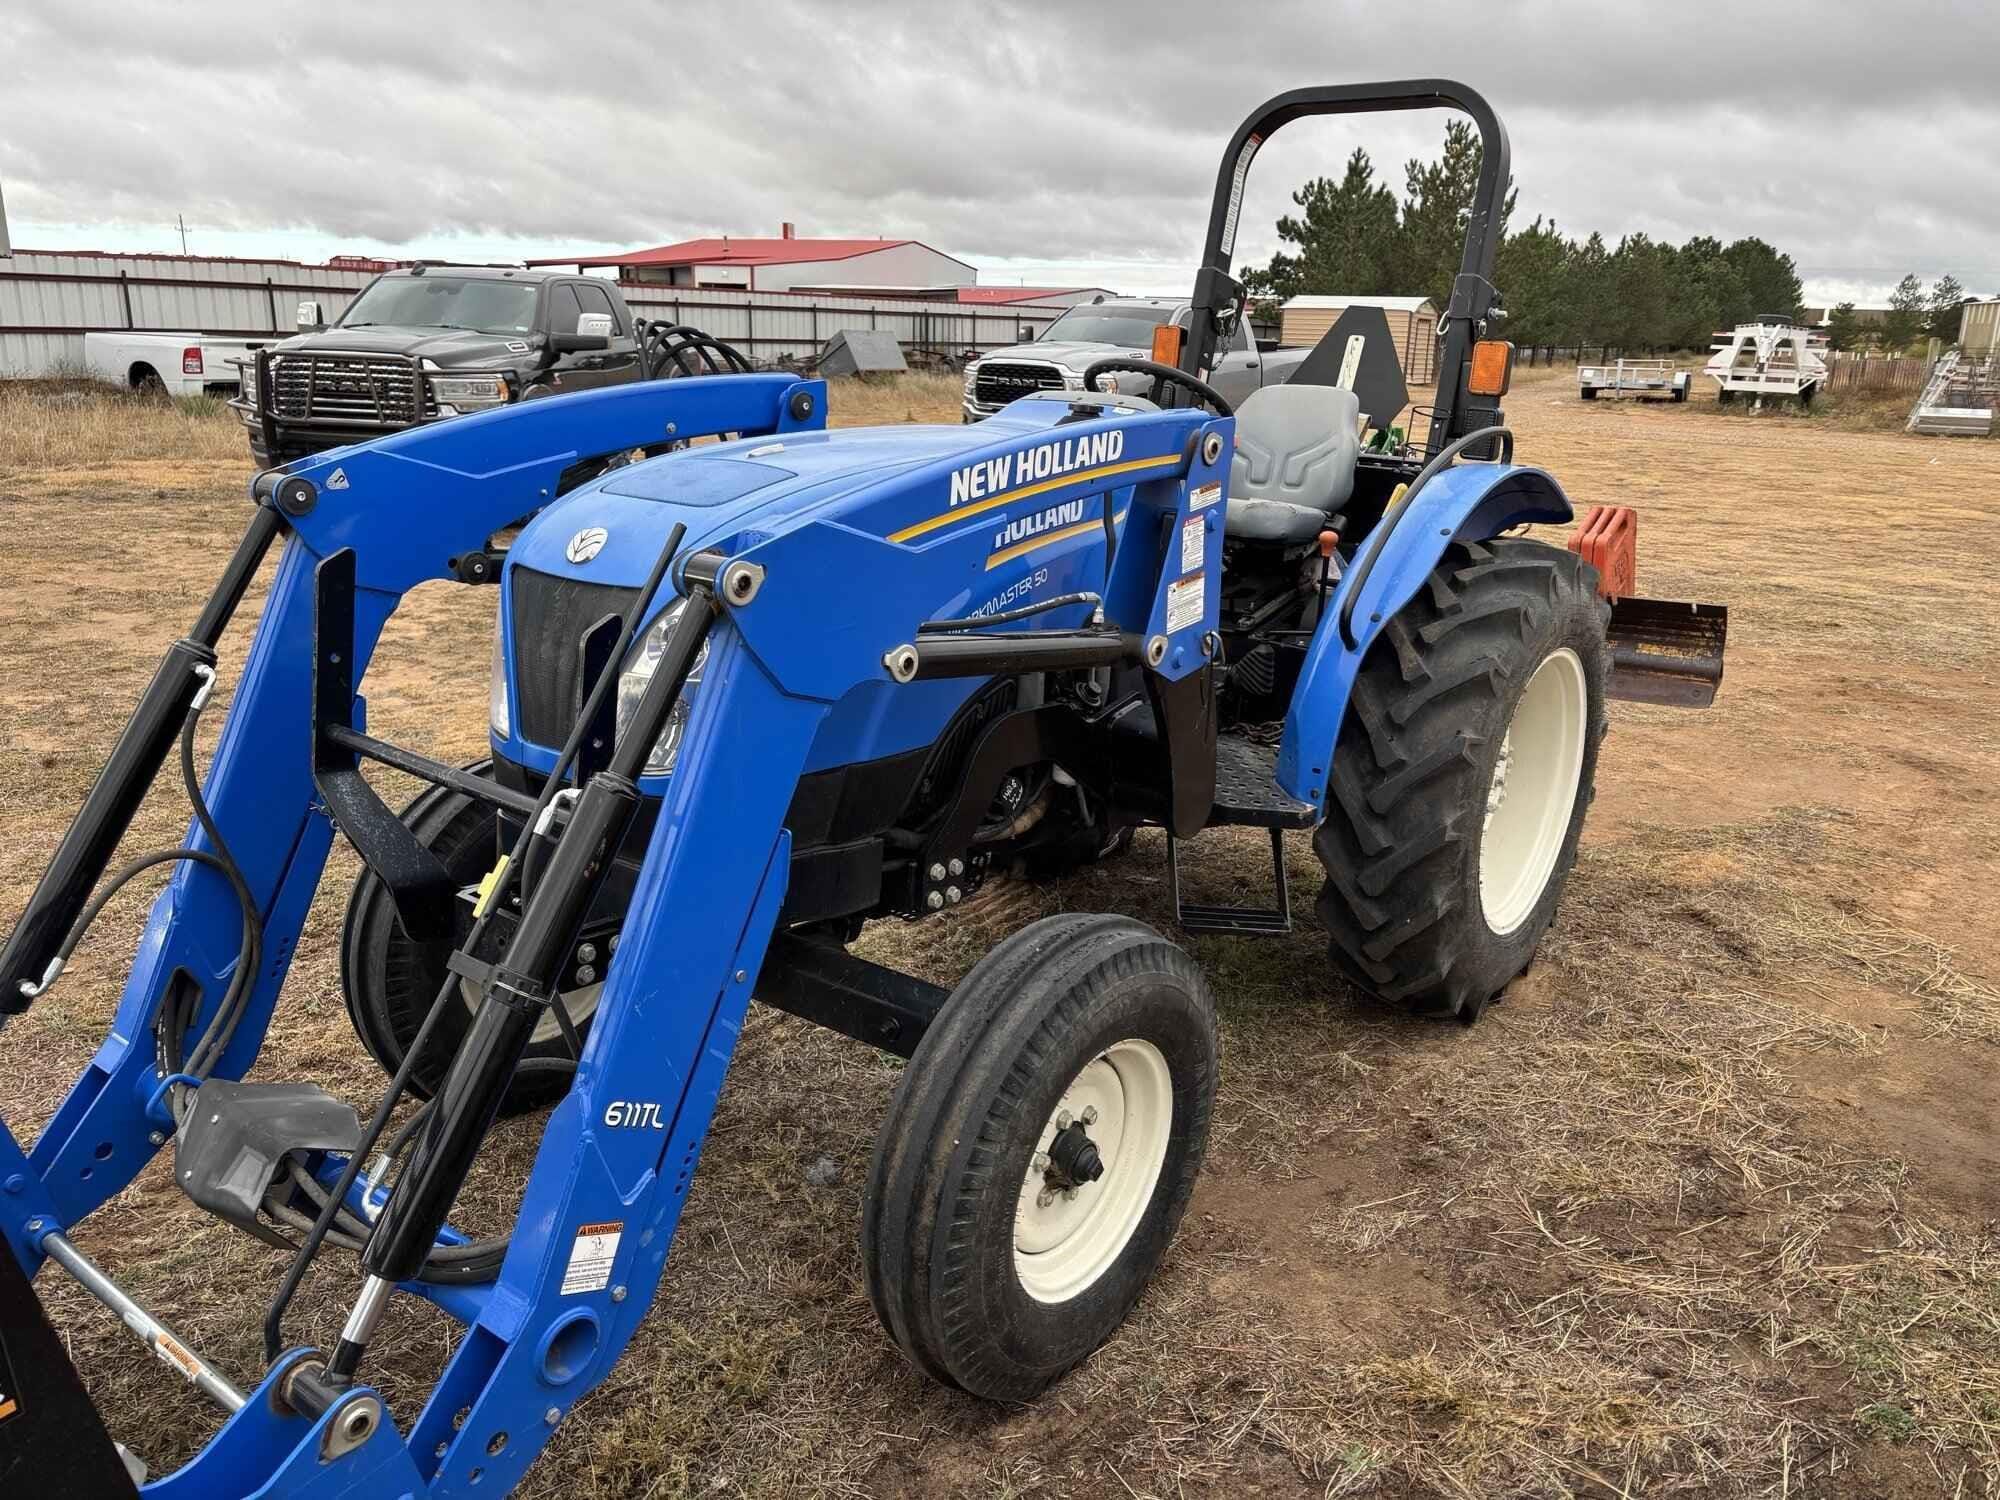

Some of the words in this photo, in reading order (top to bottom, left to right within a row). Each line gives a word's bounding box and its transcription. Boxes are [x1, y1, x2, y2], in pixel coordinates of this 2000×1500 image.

[998, 377, 1036, 387] RAM
[950, 455, 1012, 506] NEW
[1015, 430, 1123, 485] HOLLAND
[1034, 568, 1048, 587] 50
[605, 1101, 664, 1129] 611TL
[587, 1223, 623, 1234] WARNING
